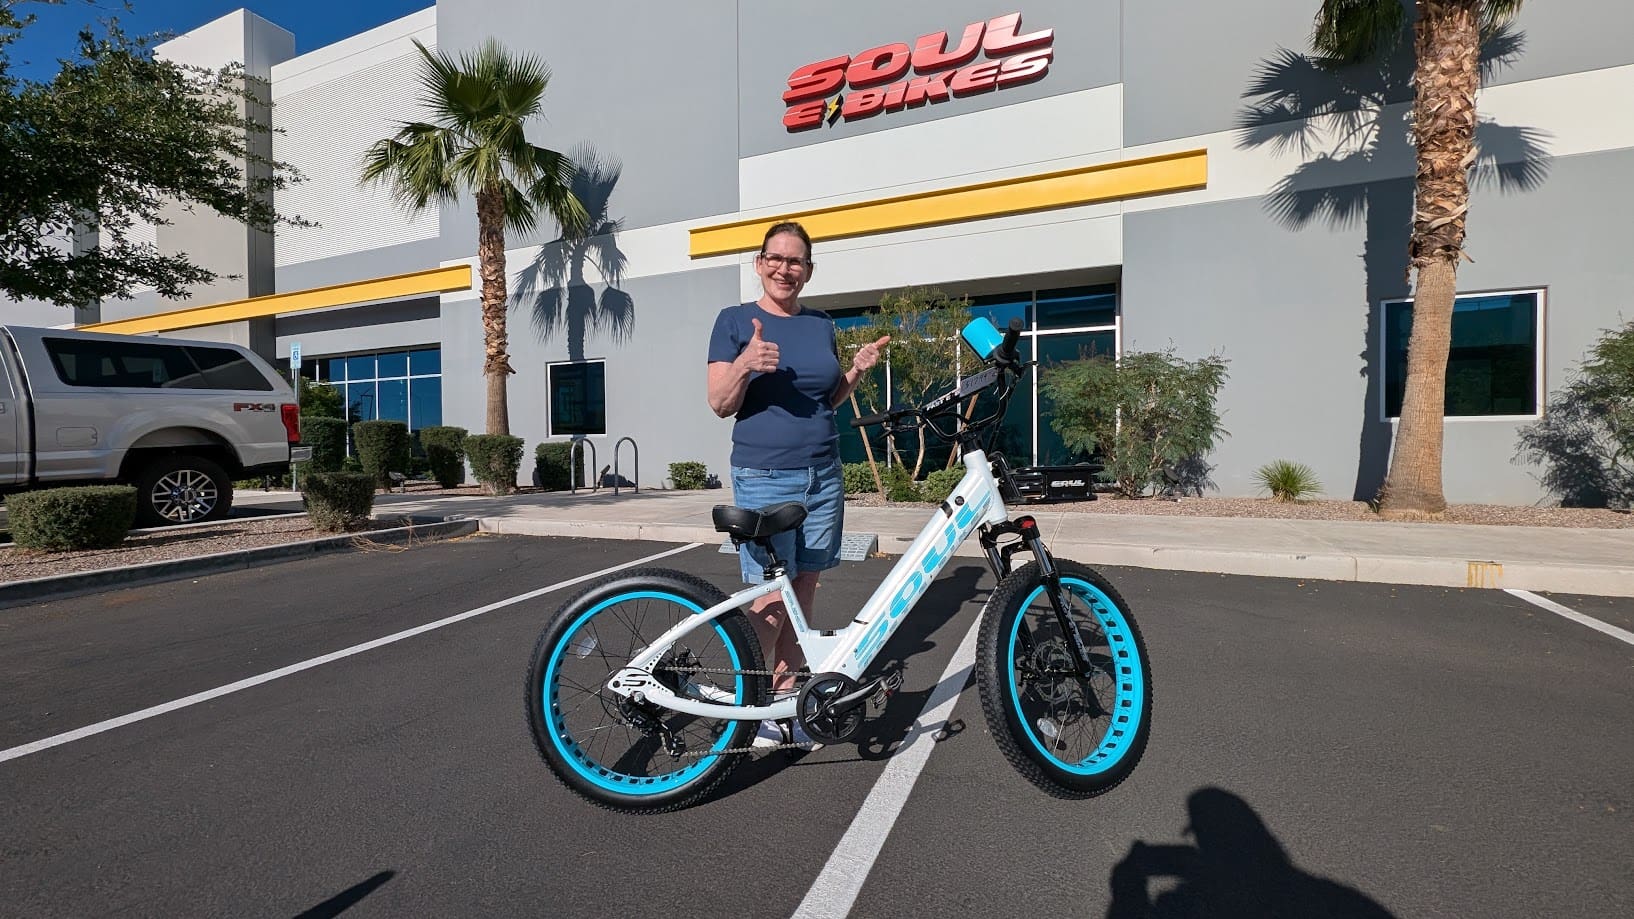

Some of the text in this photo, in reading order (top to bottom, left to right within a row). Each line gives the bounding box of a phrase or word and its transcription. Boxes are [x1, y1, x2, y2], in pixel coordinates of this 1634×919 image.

[782, 11, 1054, 106] SOUL
[233, 402, 275, 412] FX4
[853, 490, 991, 669] SOUL
